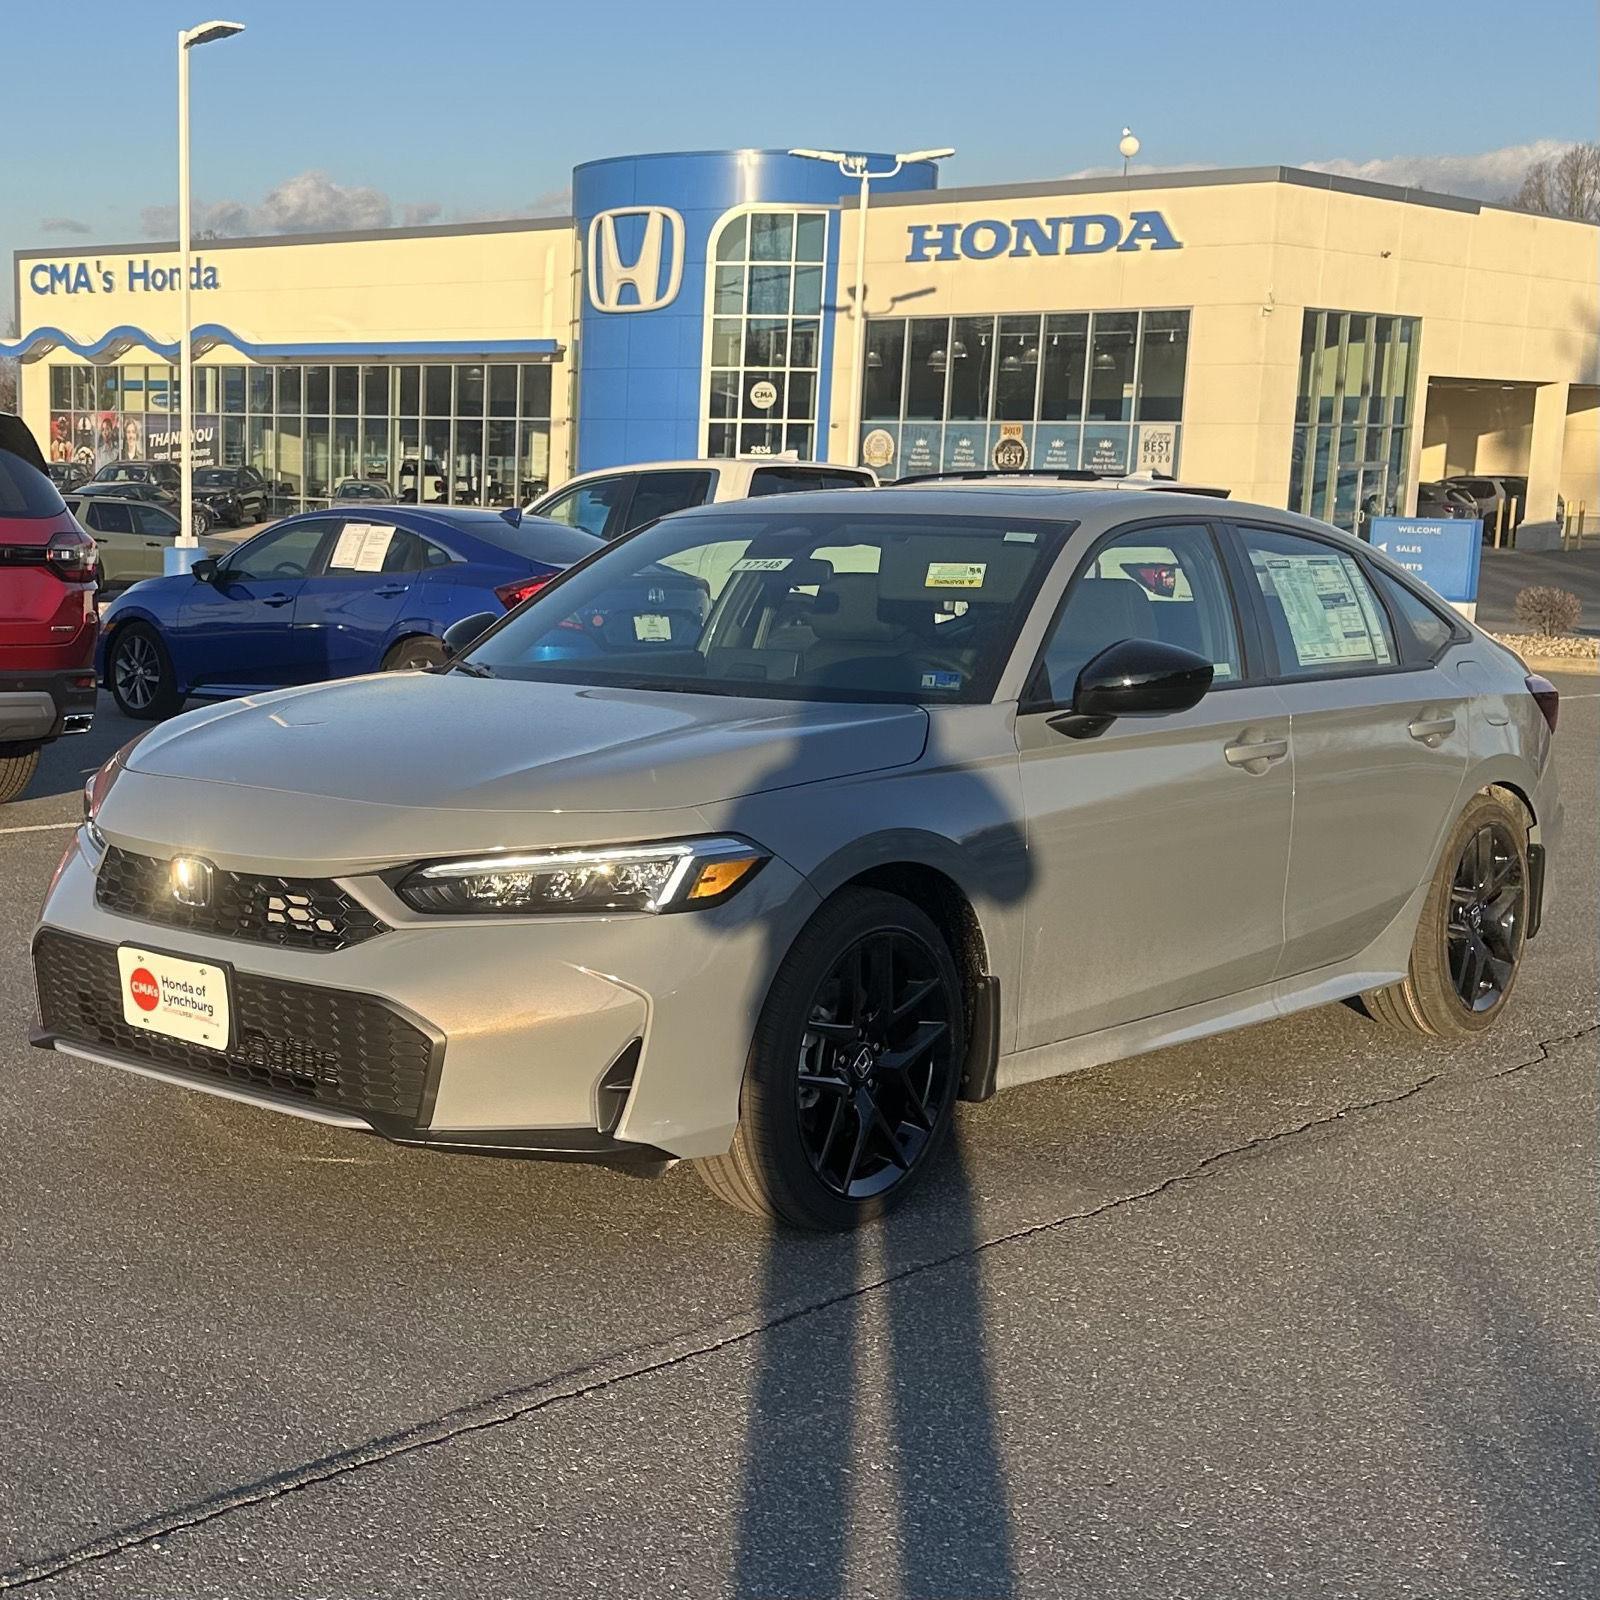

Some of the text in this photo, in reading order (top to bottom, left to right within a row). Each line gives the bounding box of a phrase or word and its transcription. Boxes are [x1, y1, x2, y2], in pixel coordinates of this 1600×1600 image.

[905, 211, 1184, 262] HONDA
[30, 257, 221, 295] CMA's Honda
[148, 431, 182, 447] THAN
[1144, 441, 1170, 452] BEST
[997, 453, 1021, 464] BEST
[1143, 455, 1170, 463] 2020
[1398, 526, 1442, 535] WELCOME
[1396, 545, 1422, 553] SALES
[1399, 563, 1423, 571] ARTS
[131, 981, 159, 998] CMA's
[161, 975, 206, 998] Honda of
[162, 990, 214, 1016] Lynchburg
